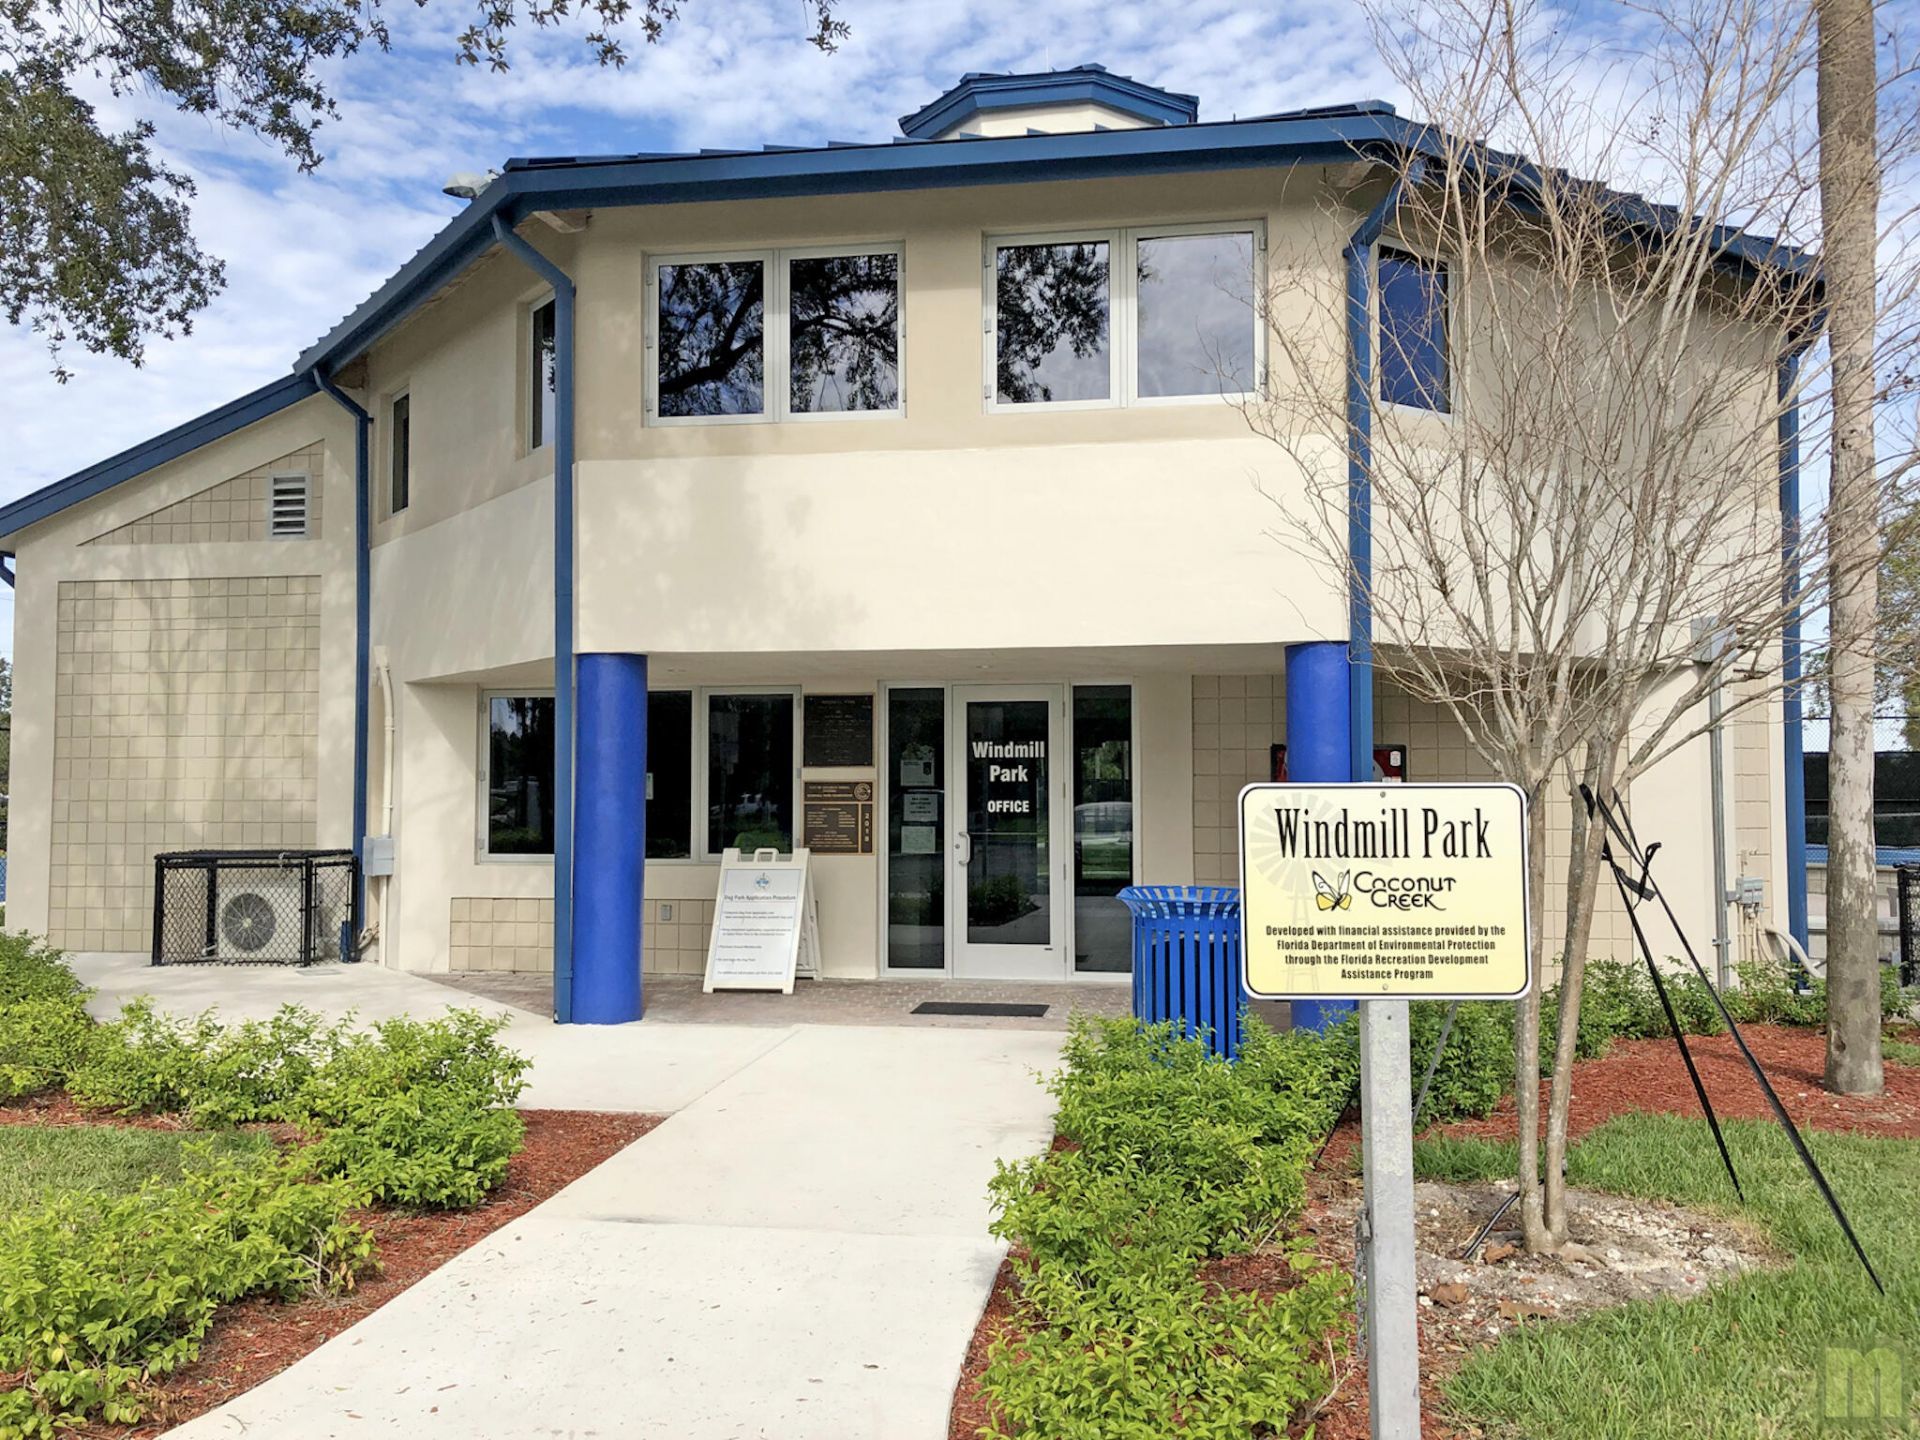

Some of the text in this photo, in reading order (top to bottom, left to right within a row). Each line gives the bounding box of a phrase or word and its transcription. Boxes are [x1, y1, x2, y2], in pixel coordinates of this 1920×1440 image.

[972, 741, 1045, 759] Windmill
[989, 765, 1028, 782] Park
[987, 800, 1030, 813] OFFICE
[1274, 808, 1493, 859] Windmill Park
[1266, 925, 1506, 937] Developed with financial assistance provided by the
[1277, 940, 1496, 951] Florida Department of Environmental Protection
[1285, 954, 1489, 966] through the Florida Recreation Development
[1341, 968, 1434, 980] Assistance Program
